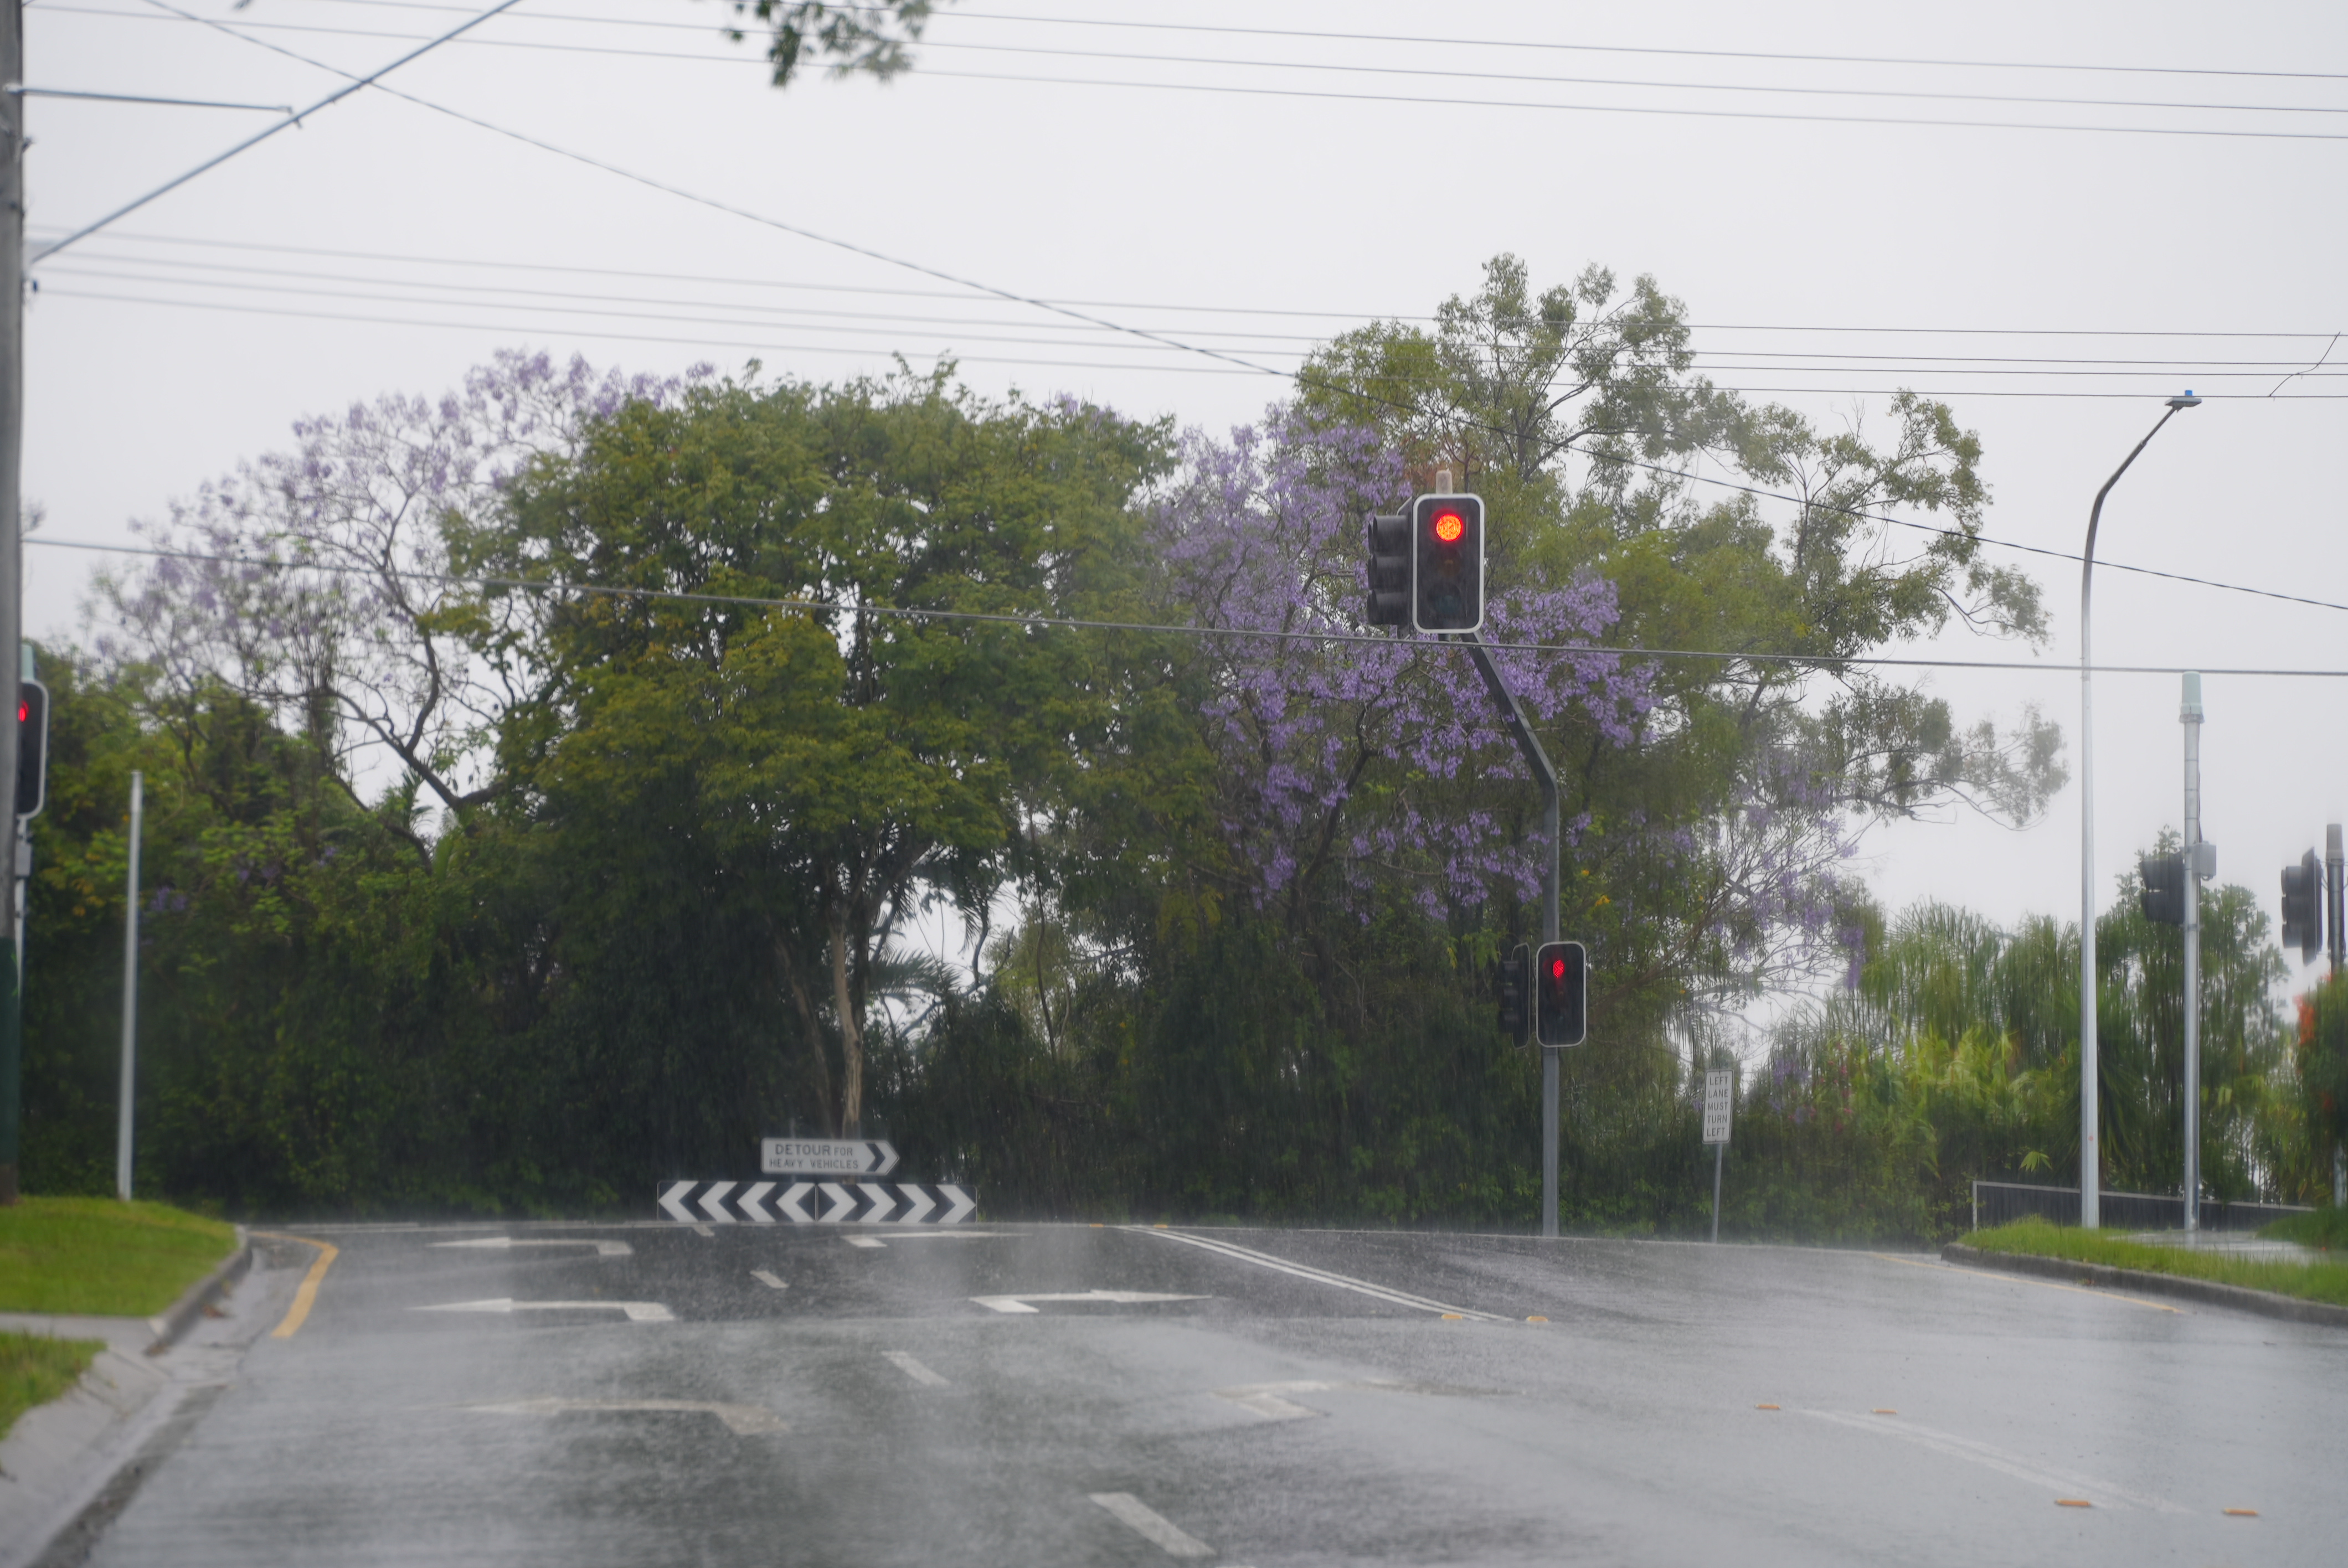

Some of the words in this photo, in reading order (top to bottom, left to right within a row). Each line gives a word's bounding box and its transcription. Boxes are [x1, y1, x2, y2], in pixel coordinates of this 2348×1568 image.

[1709, 1076, 1728, 1086] LEFT
[1708, 1089, 1728, 1098] LANE
[1707, 1102, 1728, 1111] MUST
[1707, 1114, 1727, 1124] TURN
[1707, 1127, 1726, 1137] LEFT
[775, 1144, 830, 1155] DETOUR
[834, 1147, 853, 1156] FOR
[769, 1158, 803, 1167] HEAVY
[810, 1159, 858, 1169] VEHICLES
